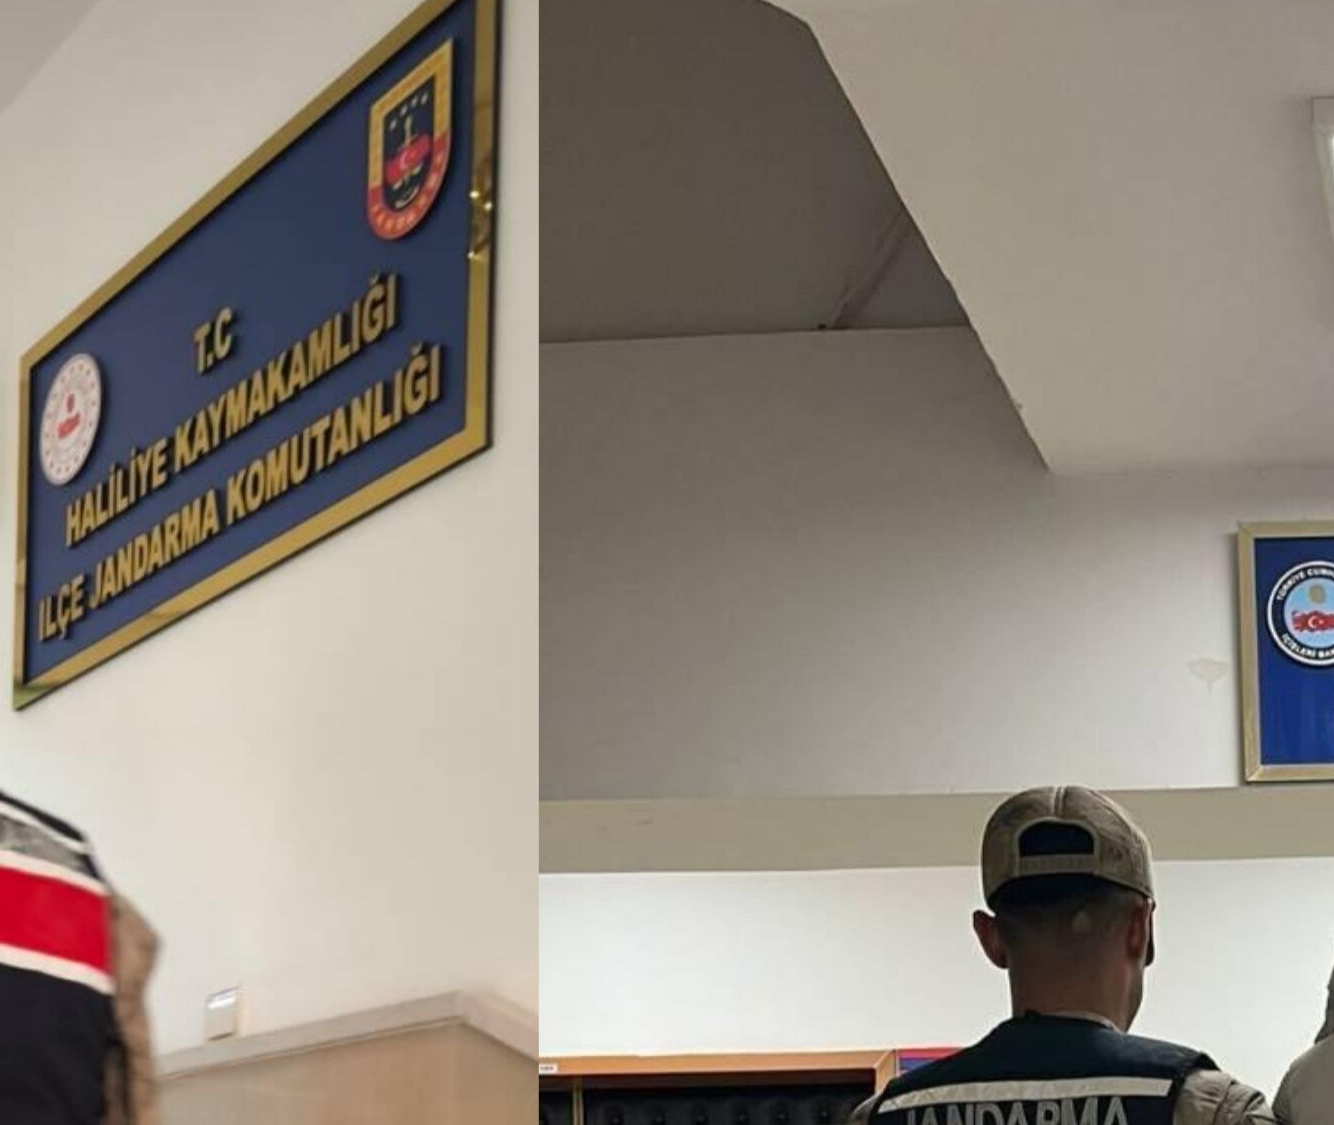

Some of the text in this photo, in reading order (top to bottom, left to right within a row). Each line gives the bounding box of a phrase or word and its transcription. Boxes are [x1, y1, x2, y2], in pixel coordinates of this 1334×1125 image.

[64, 270, 398, 548] HALİLİYE KAYMAKAMLIĞI
[193, 306, 234, 374] T.C
[88, 487, 220, 610] JANDARMA
[225, 342, 442, 525] KOMUTANLIĞI
